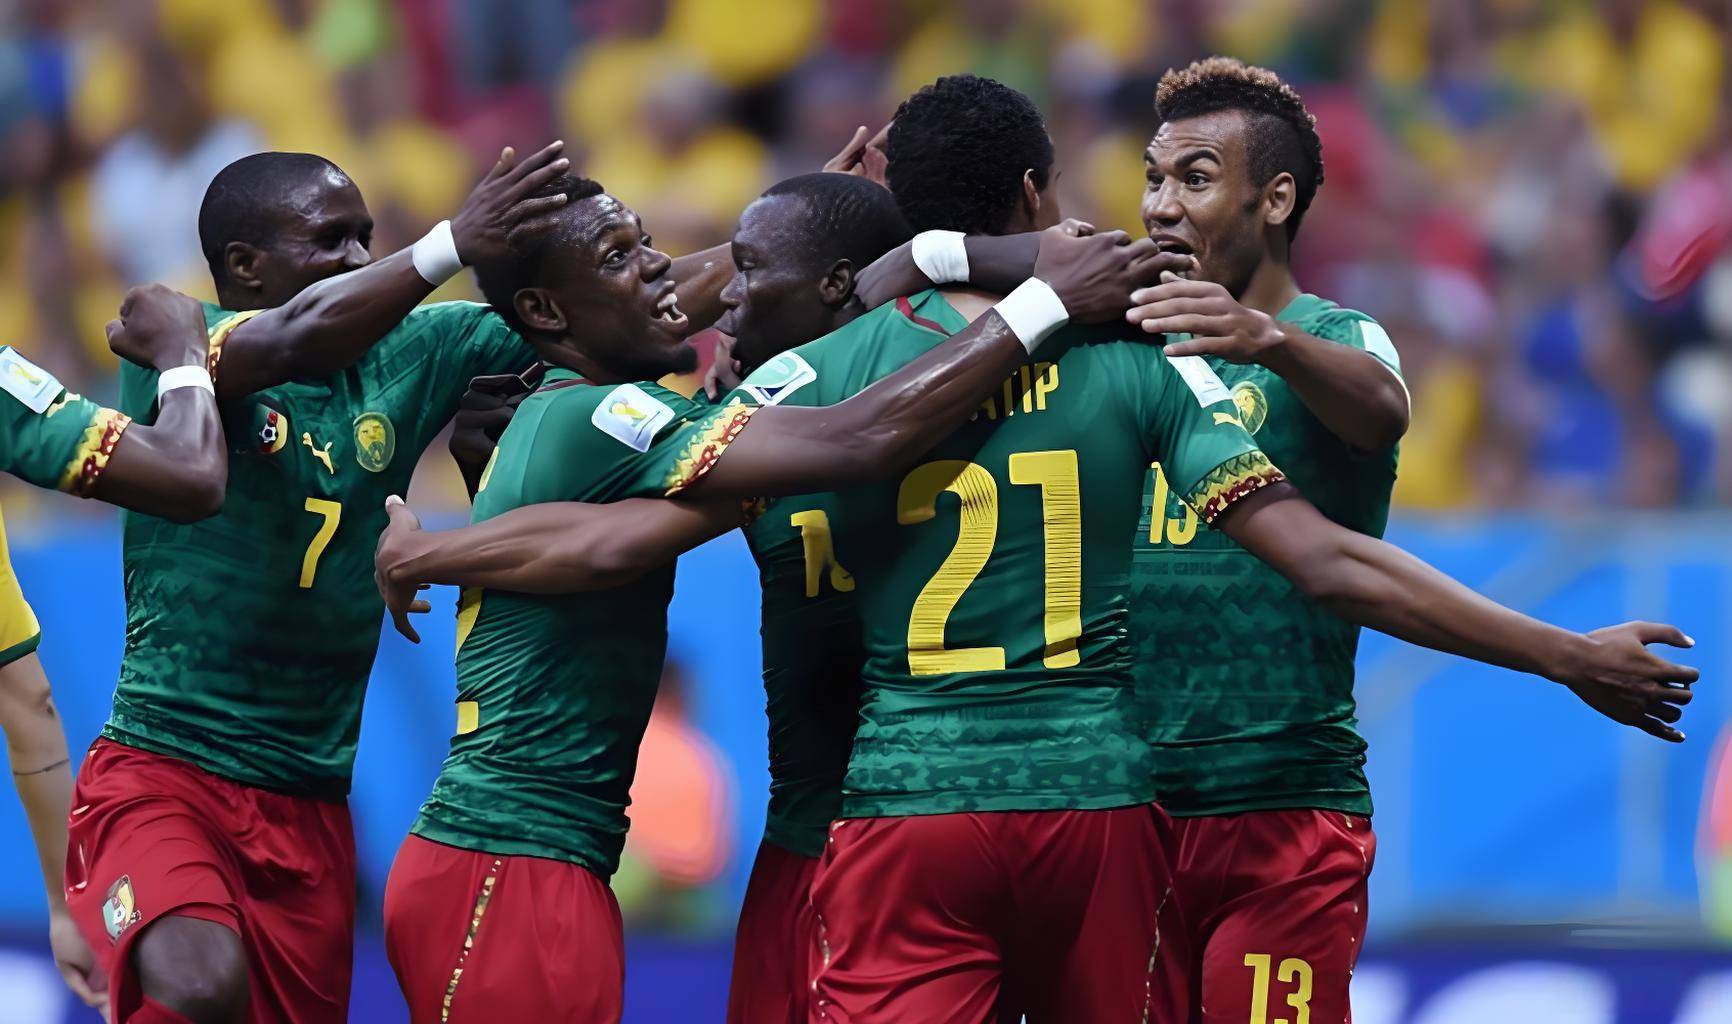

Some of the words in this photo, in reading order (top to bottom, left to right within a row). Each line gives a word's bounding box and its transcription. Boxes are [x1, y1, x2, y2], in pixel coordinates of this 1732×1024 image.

[299, 497, 342, 589] 7
[897, 449, 1082, 676] 21
[1244, 953, 1313, 1024] 13
